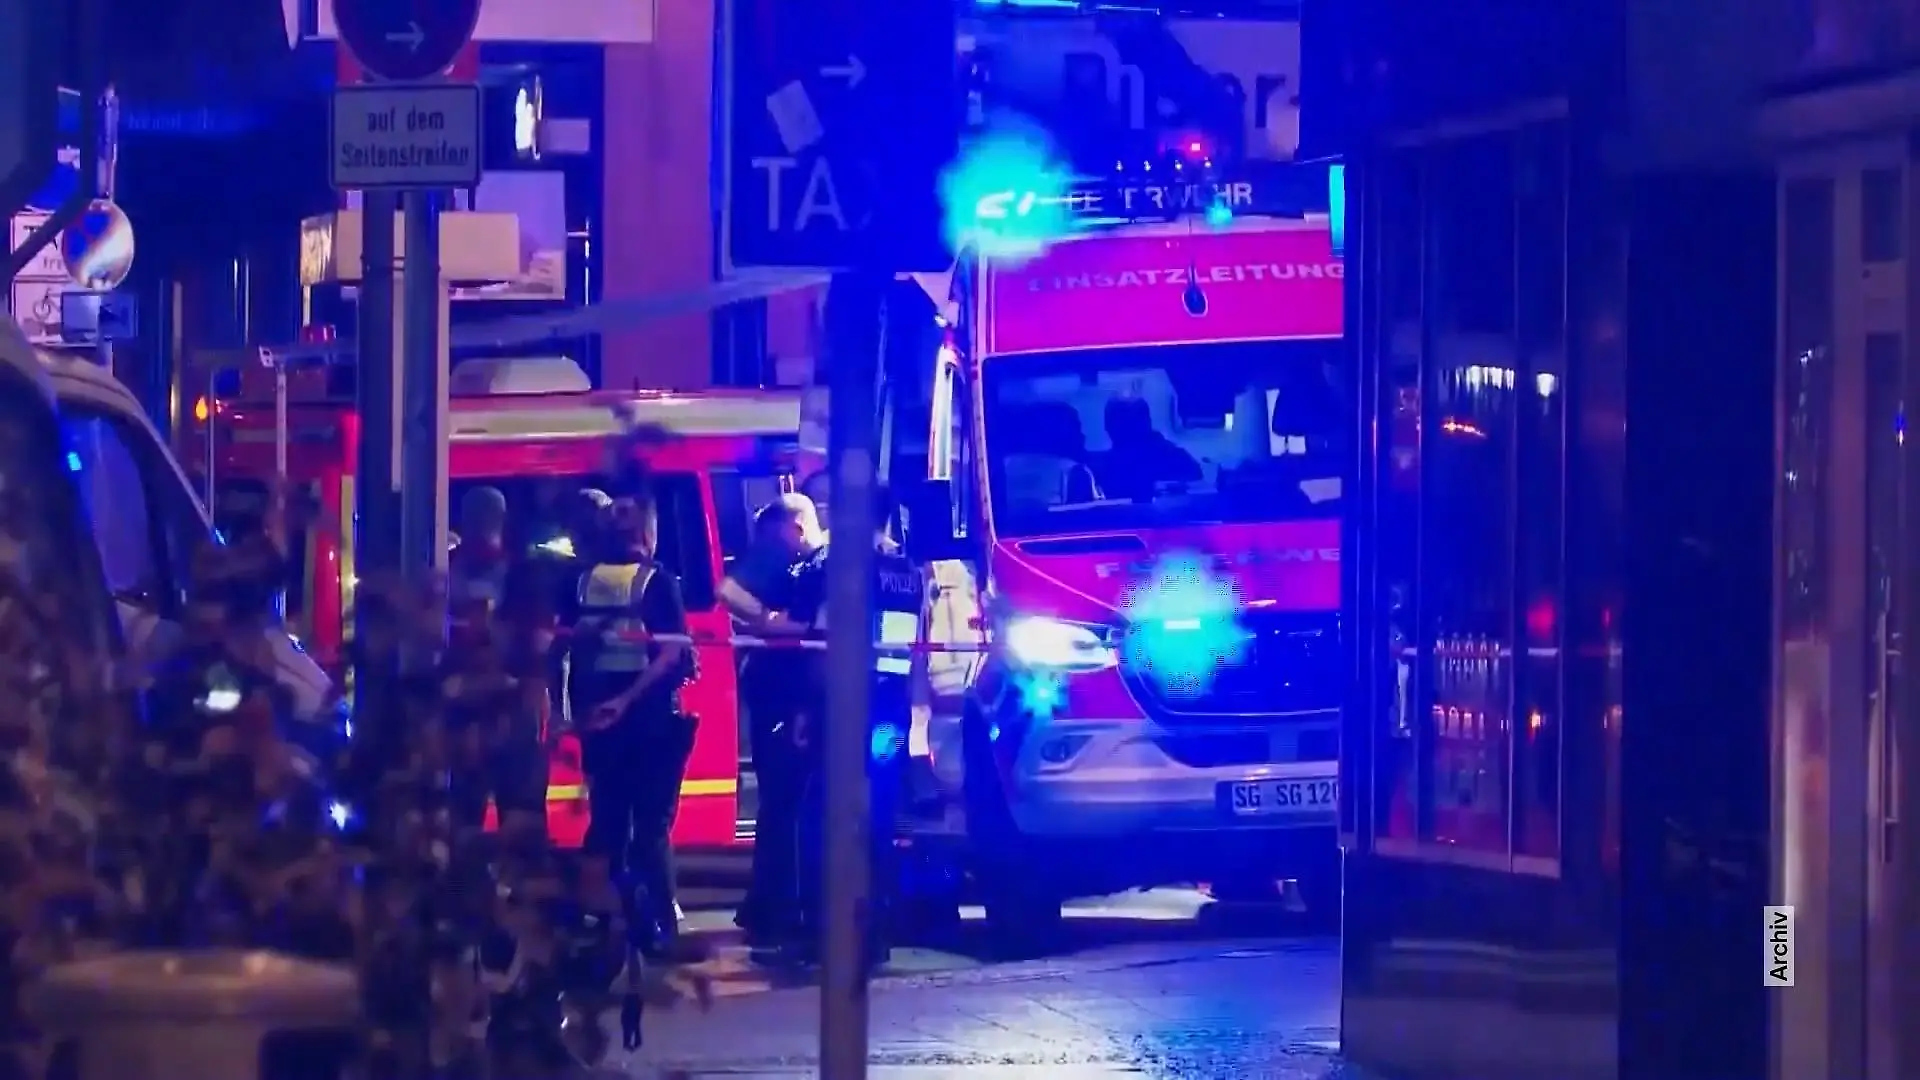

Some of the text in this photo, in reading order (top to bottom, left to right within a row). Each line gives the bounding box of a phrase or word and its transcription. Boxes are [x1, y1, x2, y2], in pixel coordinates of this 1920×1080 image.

[367, 104, 444, 132] auf dem
[342, 139, 470, 168] Seitenstreifen
[751, 156, 872, 232] TA
[1234, 784, 1260, 808] SG
[1276, 783, 1301, 806] SG
